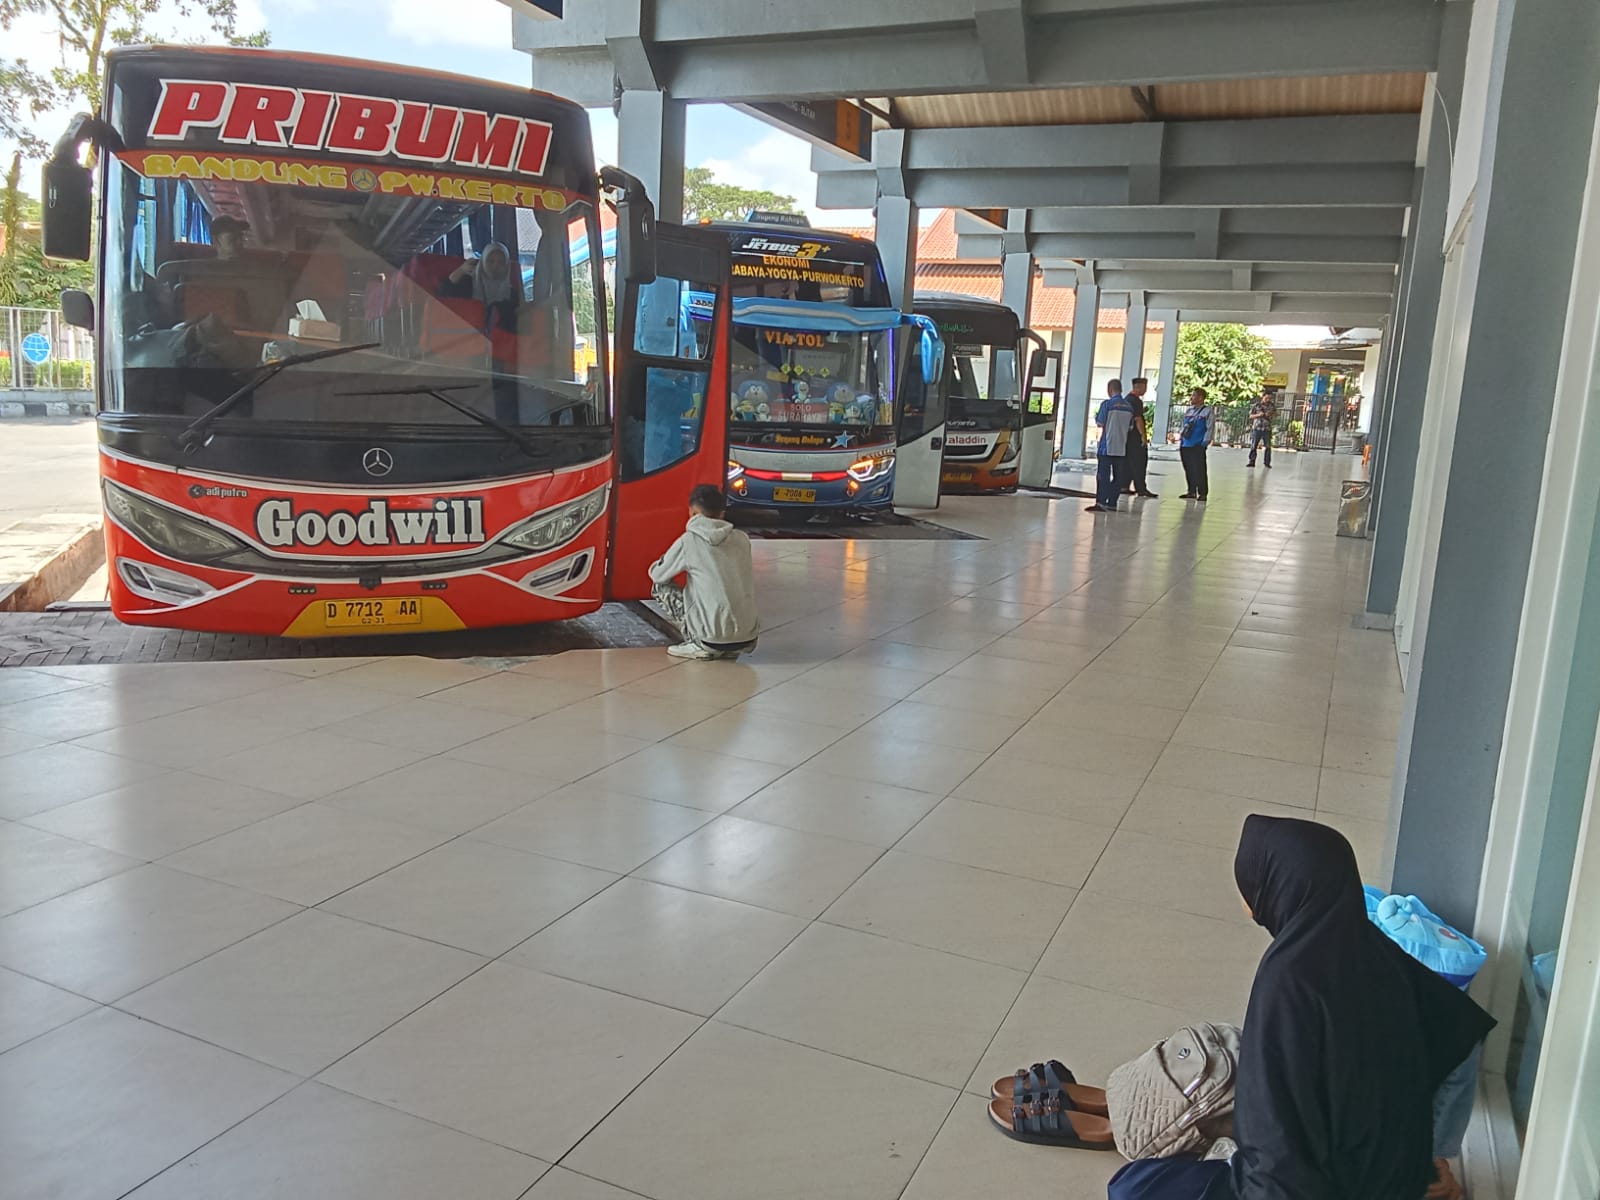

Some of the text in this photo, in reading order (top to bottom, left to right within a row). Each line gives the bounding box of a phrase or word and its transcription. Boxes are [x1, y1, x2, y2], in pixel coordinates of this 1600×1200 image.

[147, 79, 552, 176] PRIBUMI
[142, 154, 347, 189] BANDUNG
[763, 255, 810, 269] EKONOMI
[948, 436, 986, 444] aladdin
[256, 499, 485, 546] Goodwill
[327, 601, 417, 618] D 7712 AA
